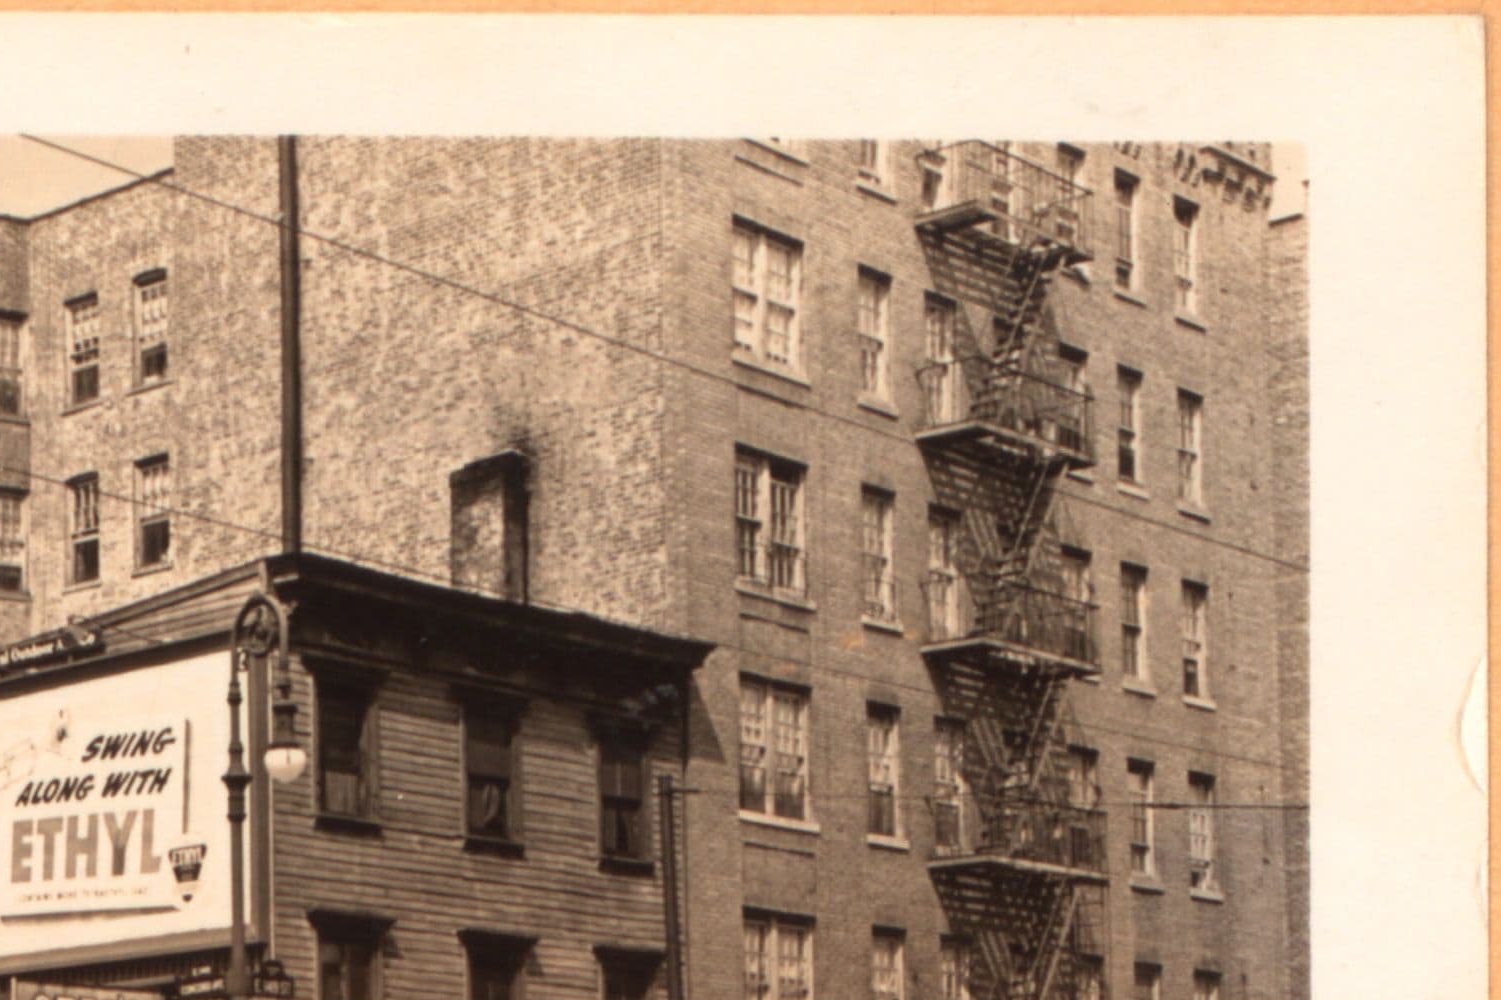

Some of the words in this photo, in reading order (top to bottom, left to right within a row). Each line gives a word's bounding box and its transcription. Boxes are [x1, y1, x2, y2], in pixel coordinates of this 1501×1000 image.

[81, 727, 176, 763] SWING
[15, 775, 94, 807] ALONG
[102, 768, 172, 798] WITH
[11, 808, 161, 883] ETHYL
